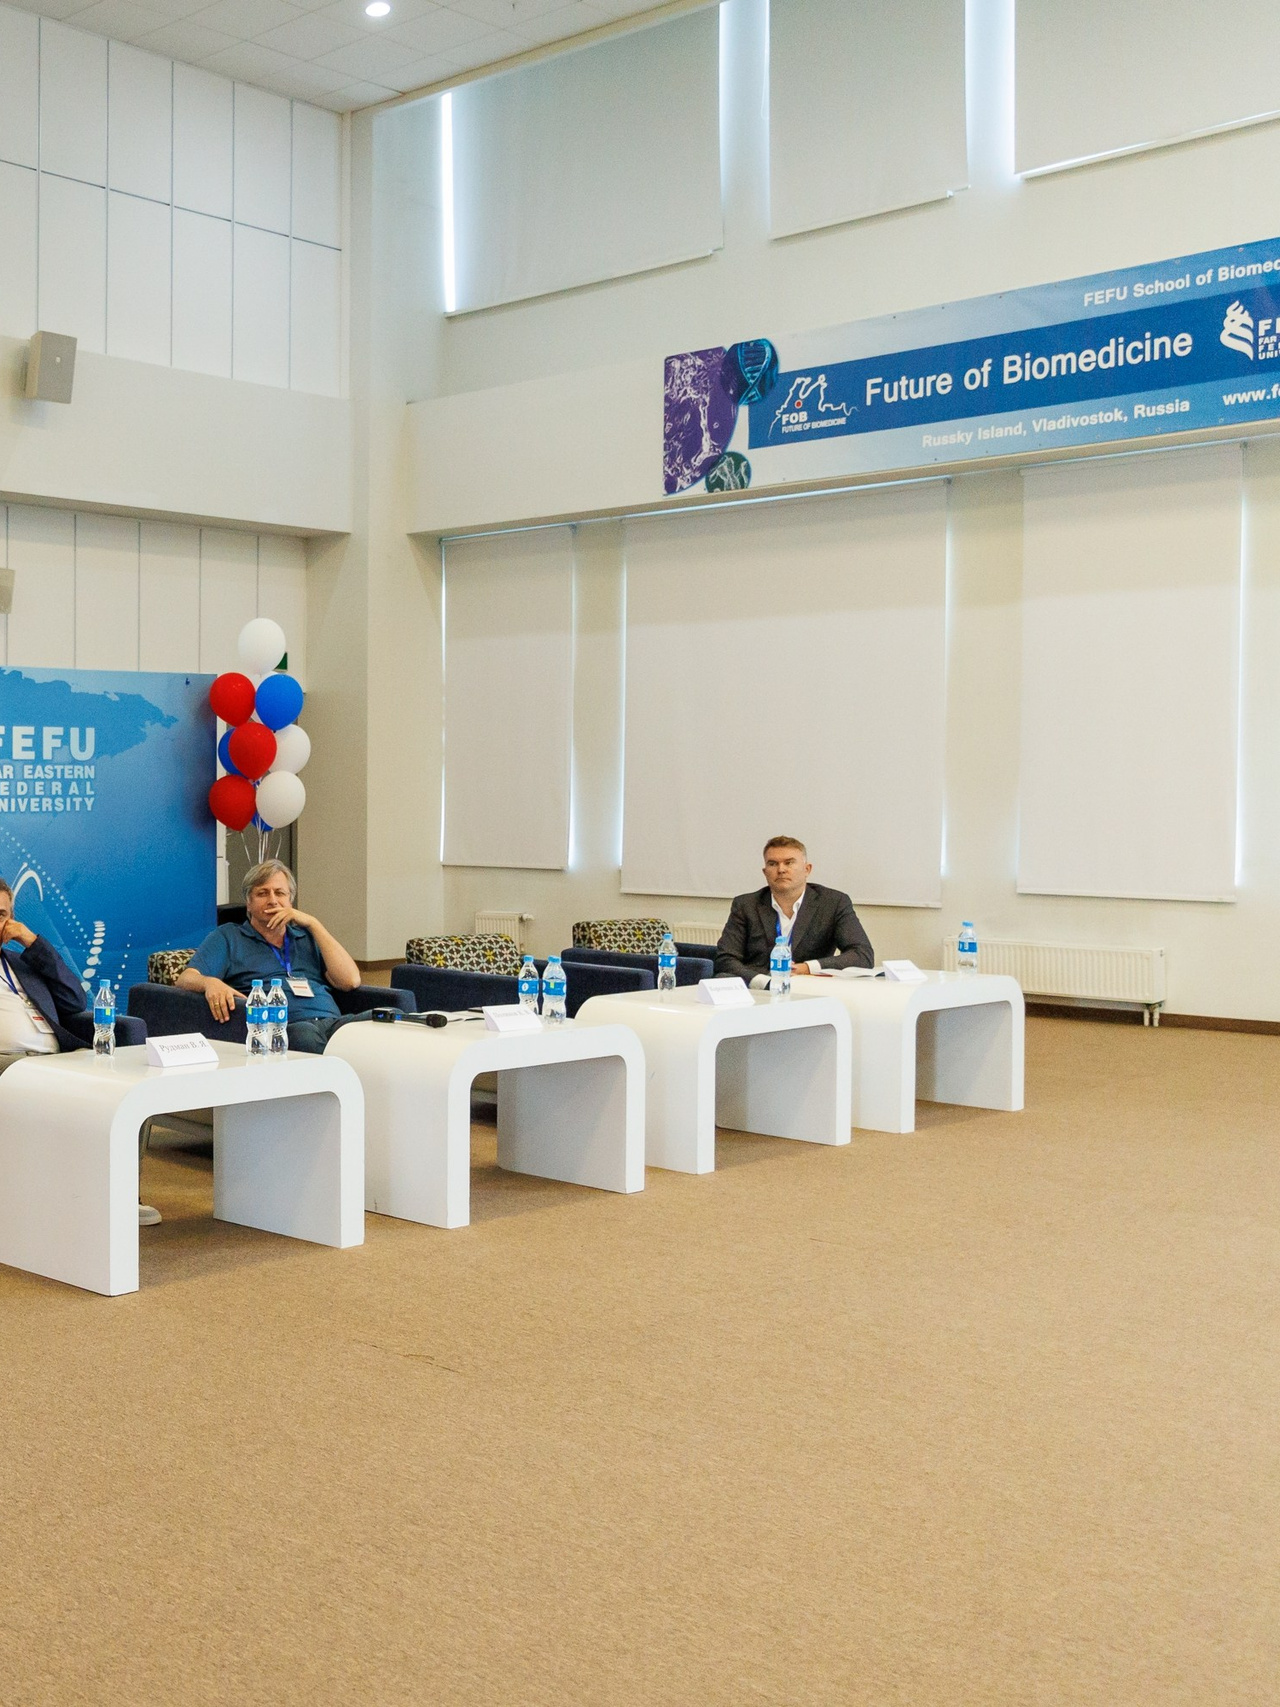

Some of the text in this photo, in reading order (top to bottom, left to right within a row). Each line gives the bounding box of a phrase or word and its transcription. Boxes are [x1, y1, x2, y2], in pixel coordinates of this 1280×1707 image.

[1083, 286, 1128, 307] FEFU
[1133, 274, 1190, 298] School
[1195, 268, 1214, 287] of
[1258, 335, 1277, 346] FAR
[1258, 343, 1280, 353] FE
[1258, 351, 1280, 360] UNI
[865, 331, 1194, 406] Future of Biomedicine
[1222, 382, 1280, 406] www.f
[781, 411, 808, 425] FOB
[922, 398, 1191, 448] Russky Island, Vladivostok, Russia
[781, 423, 803, 434] FUTURE
[802, 422, 811, 431] OF
[23, 764, 96, 780] EASTERN
